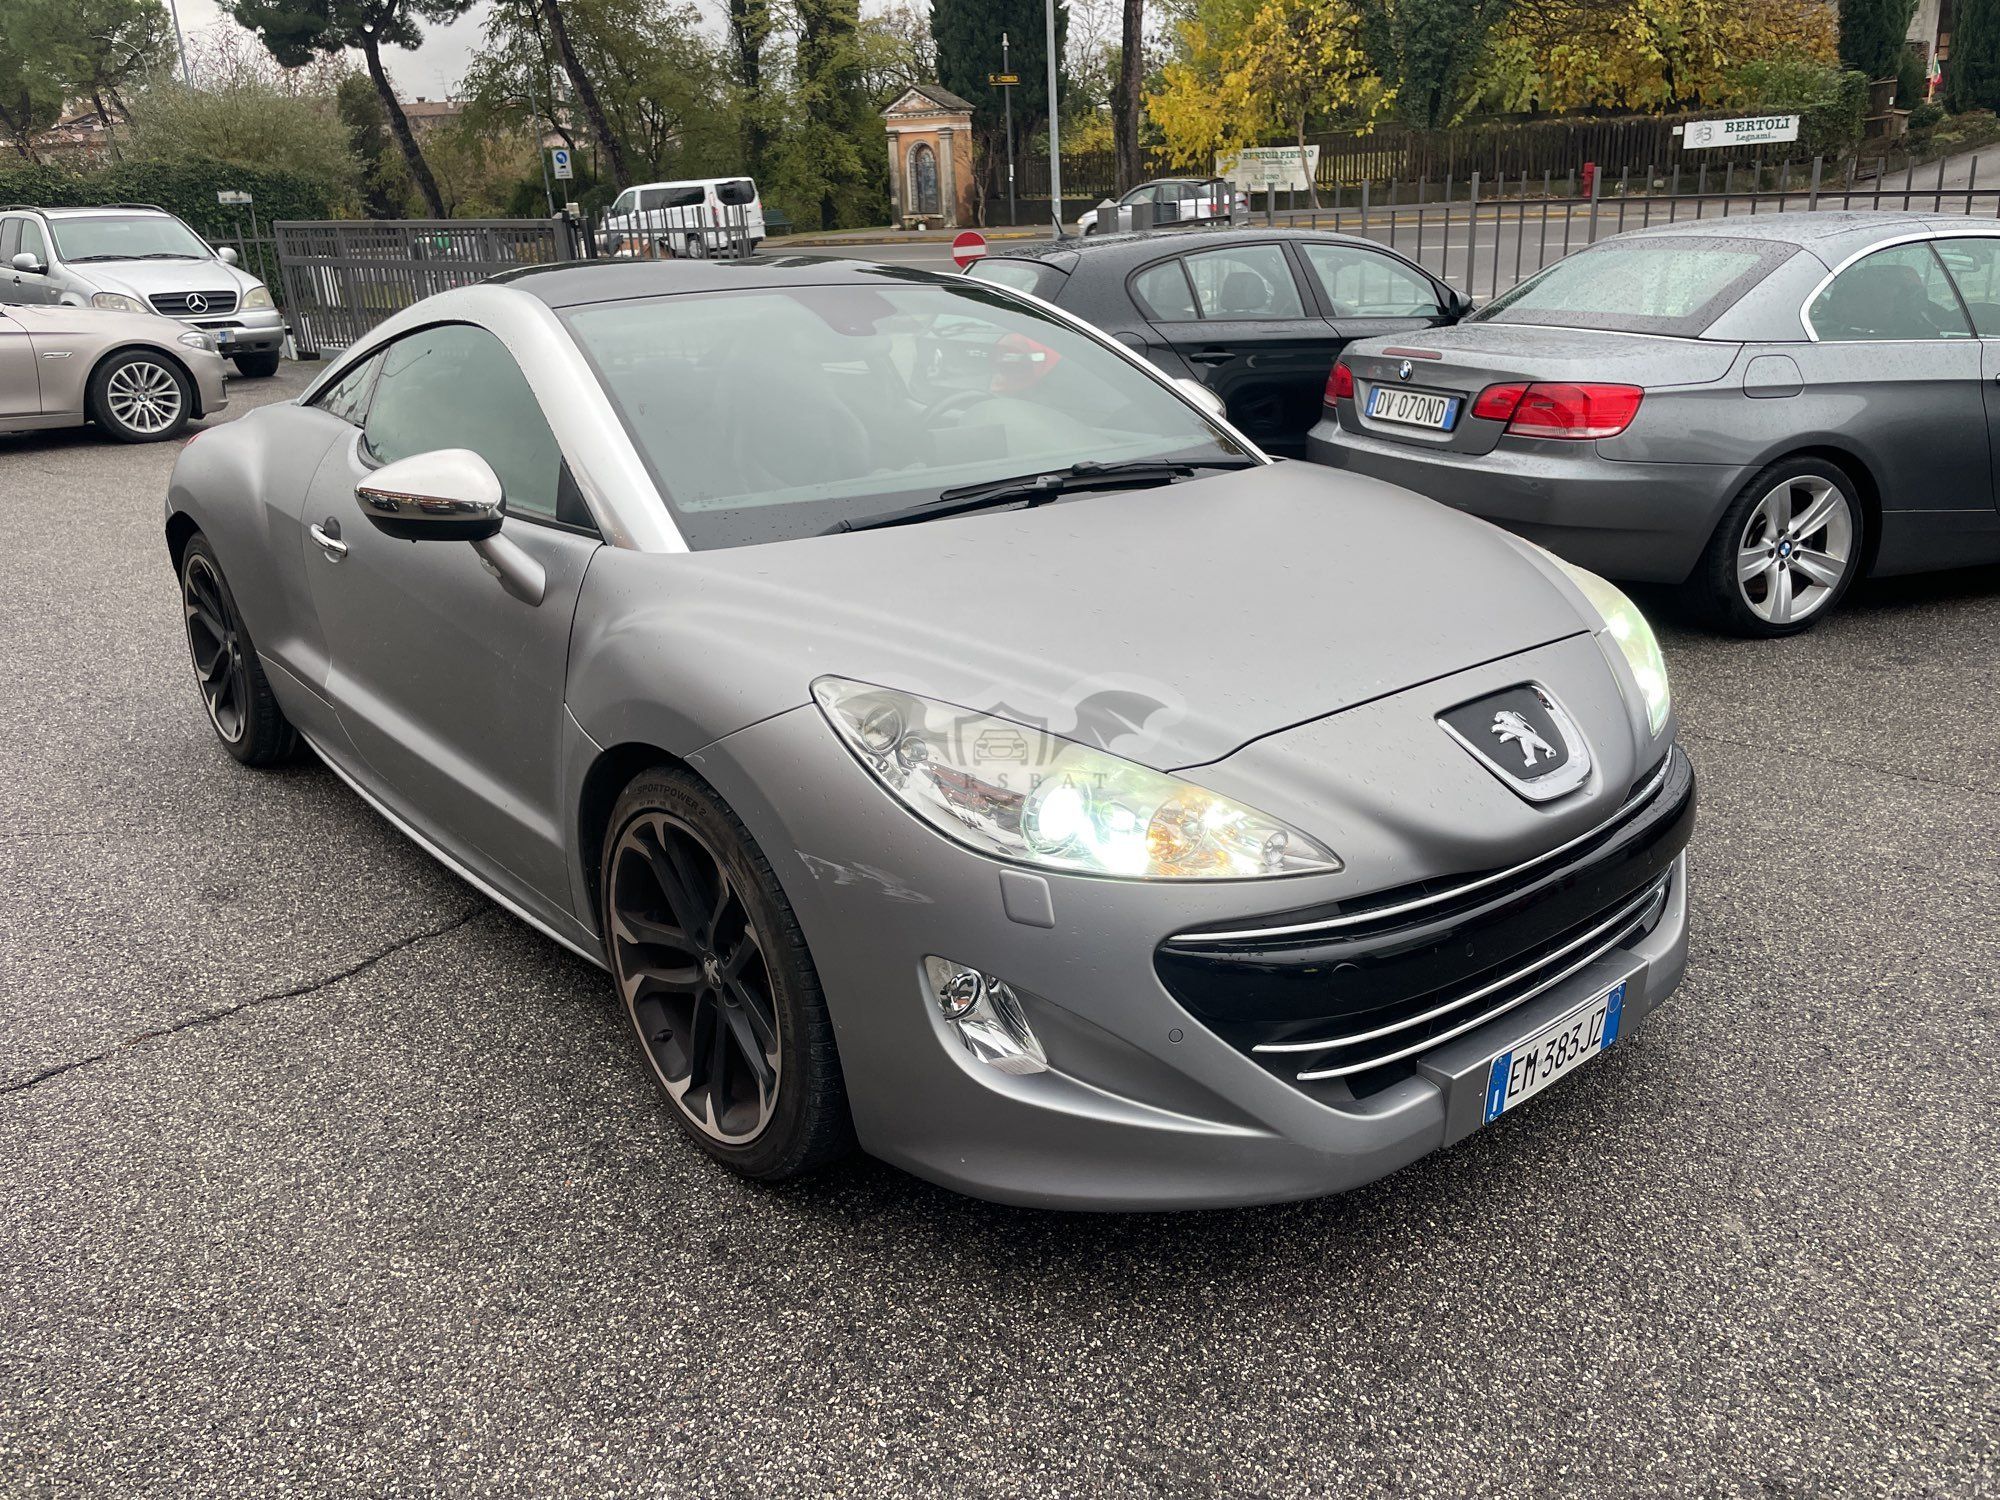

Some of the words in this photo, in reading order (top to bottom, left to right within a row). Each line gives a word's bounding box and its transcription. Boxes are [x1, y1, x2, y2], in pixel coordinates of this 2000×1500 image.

[1724, 117, 1790, 134] BERTOLI
[1735, 131, 1771, 142] Legnami
[1375, 391, 1396, 416] DV
[1397, 394, 1446, 424] 070ND
[636, 782, 700, 810] SPORTPOWER
[698, 807, 708, 817] 2
[1507, 1047, 1539, 1099] EM
[1541, 1006, 1607, 1079] 383JZ
